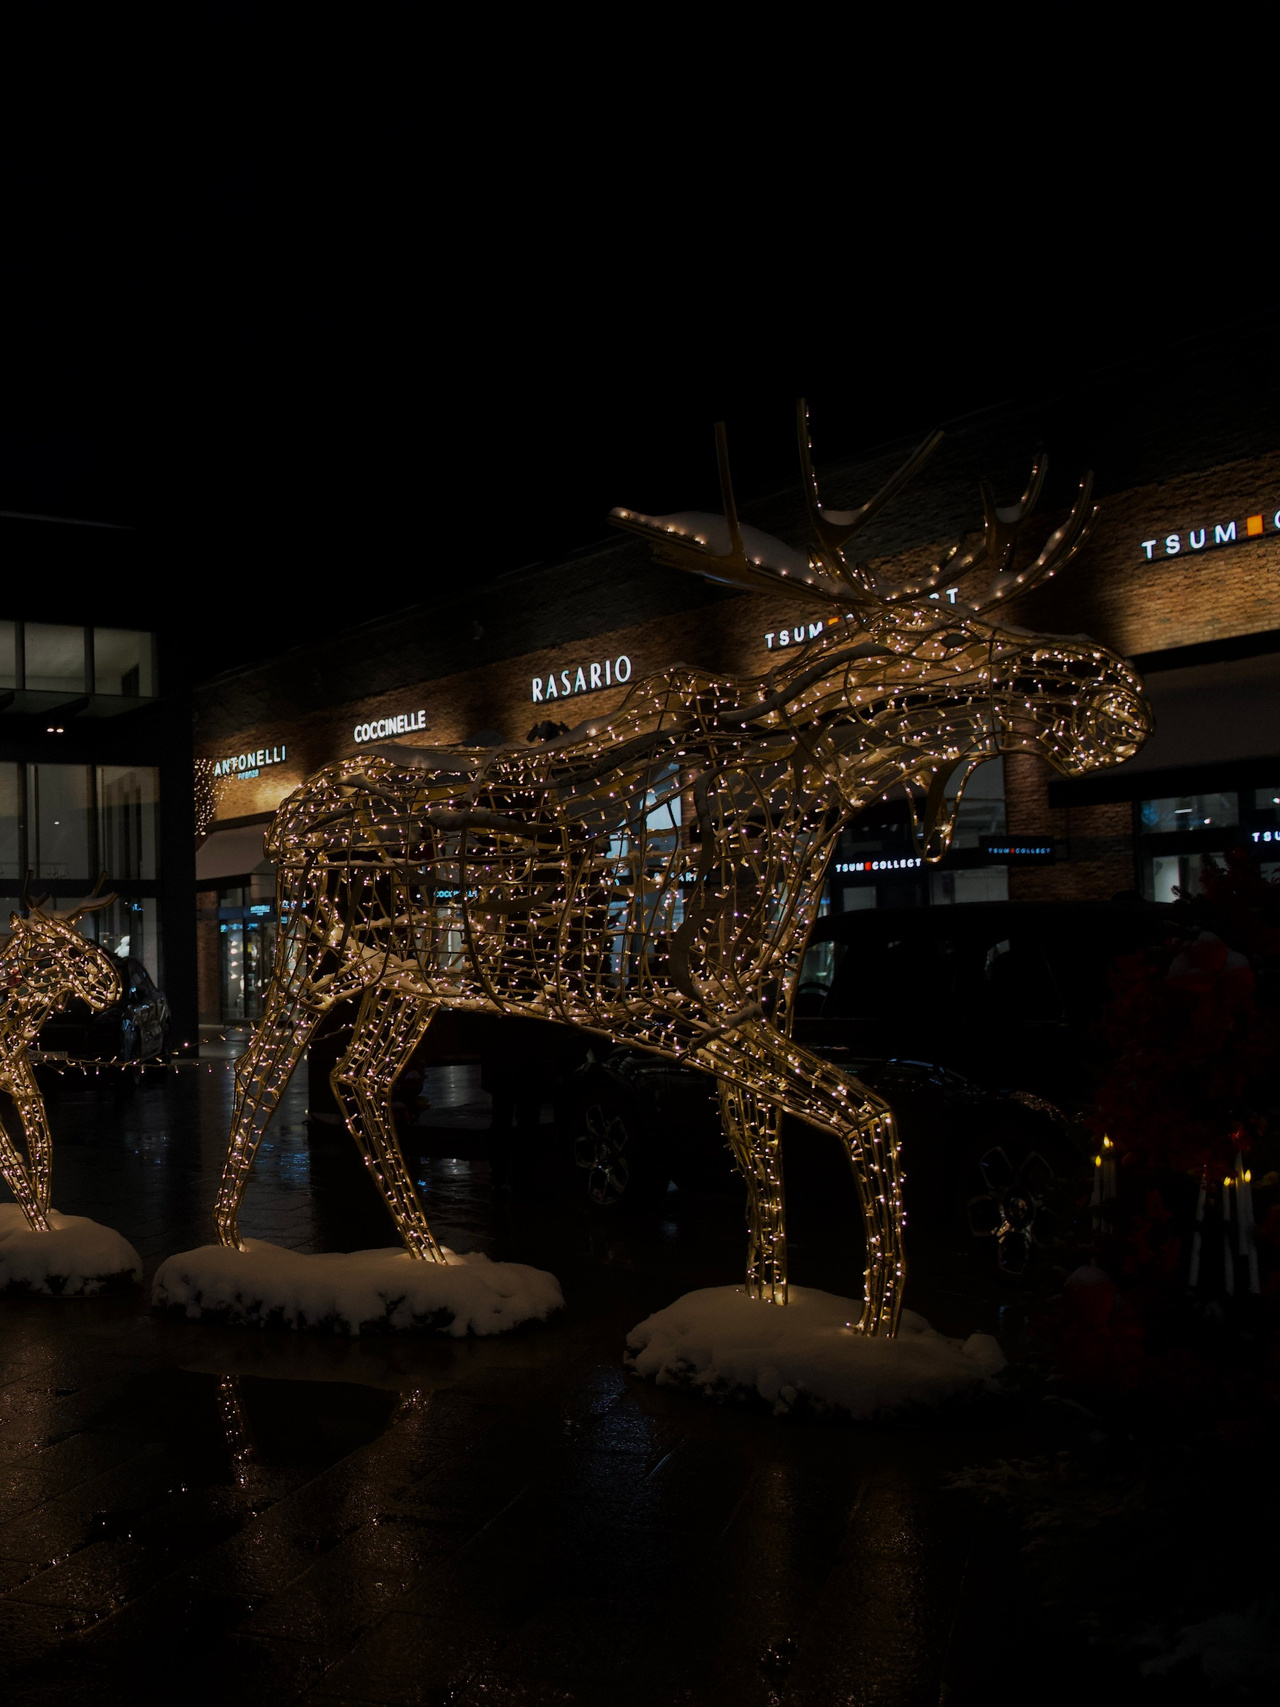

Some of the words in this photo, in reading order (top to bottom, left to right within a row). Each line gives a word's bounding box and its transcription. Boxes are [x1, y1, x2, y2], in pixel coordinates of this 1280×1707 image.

[1141, 521, 1237, 559] TSUM
[764, 621, 824, 649] TSUM
[532, 655, 632, 703] RASARIO
[354, 709, 426, 743] COCCINELLE
[214, 745, 286, 777] ANTONELLI
